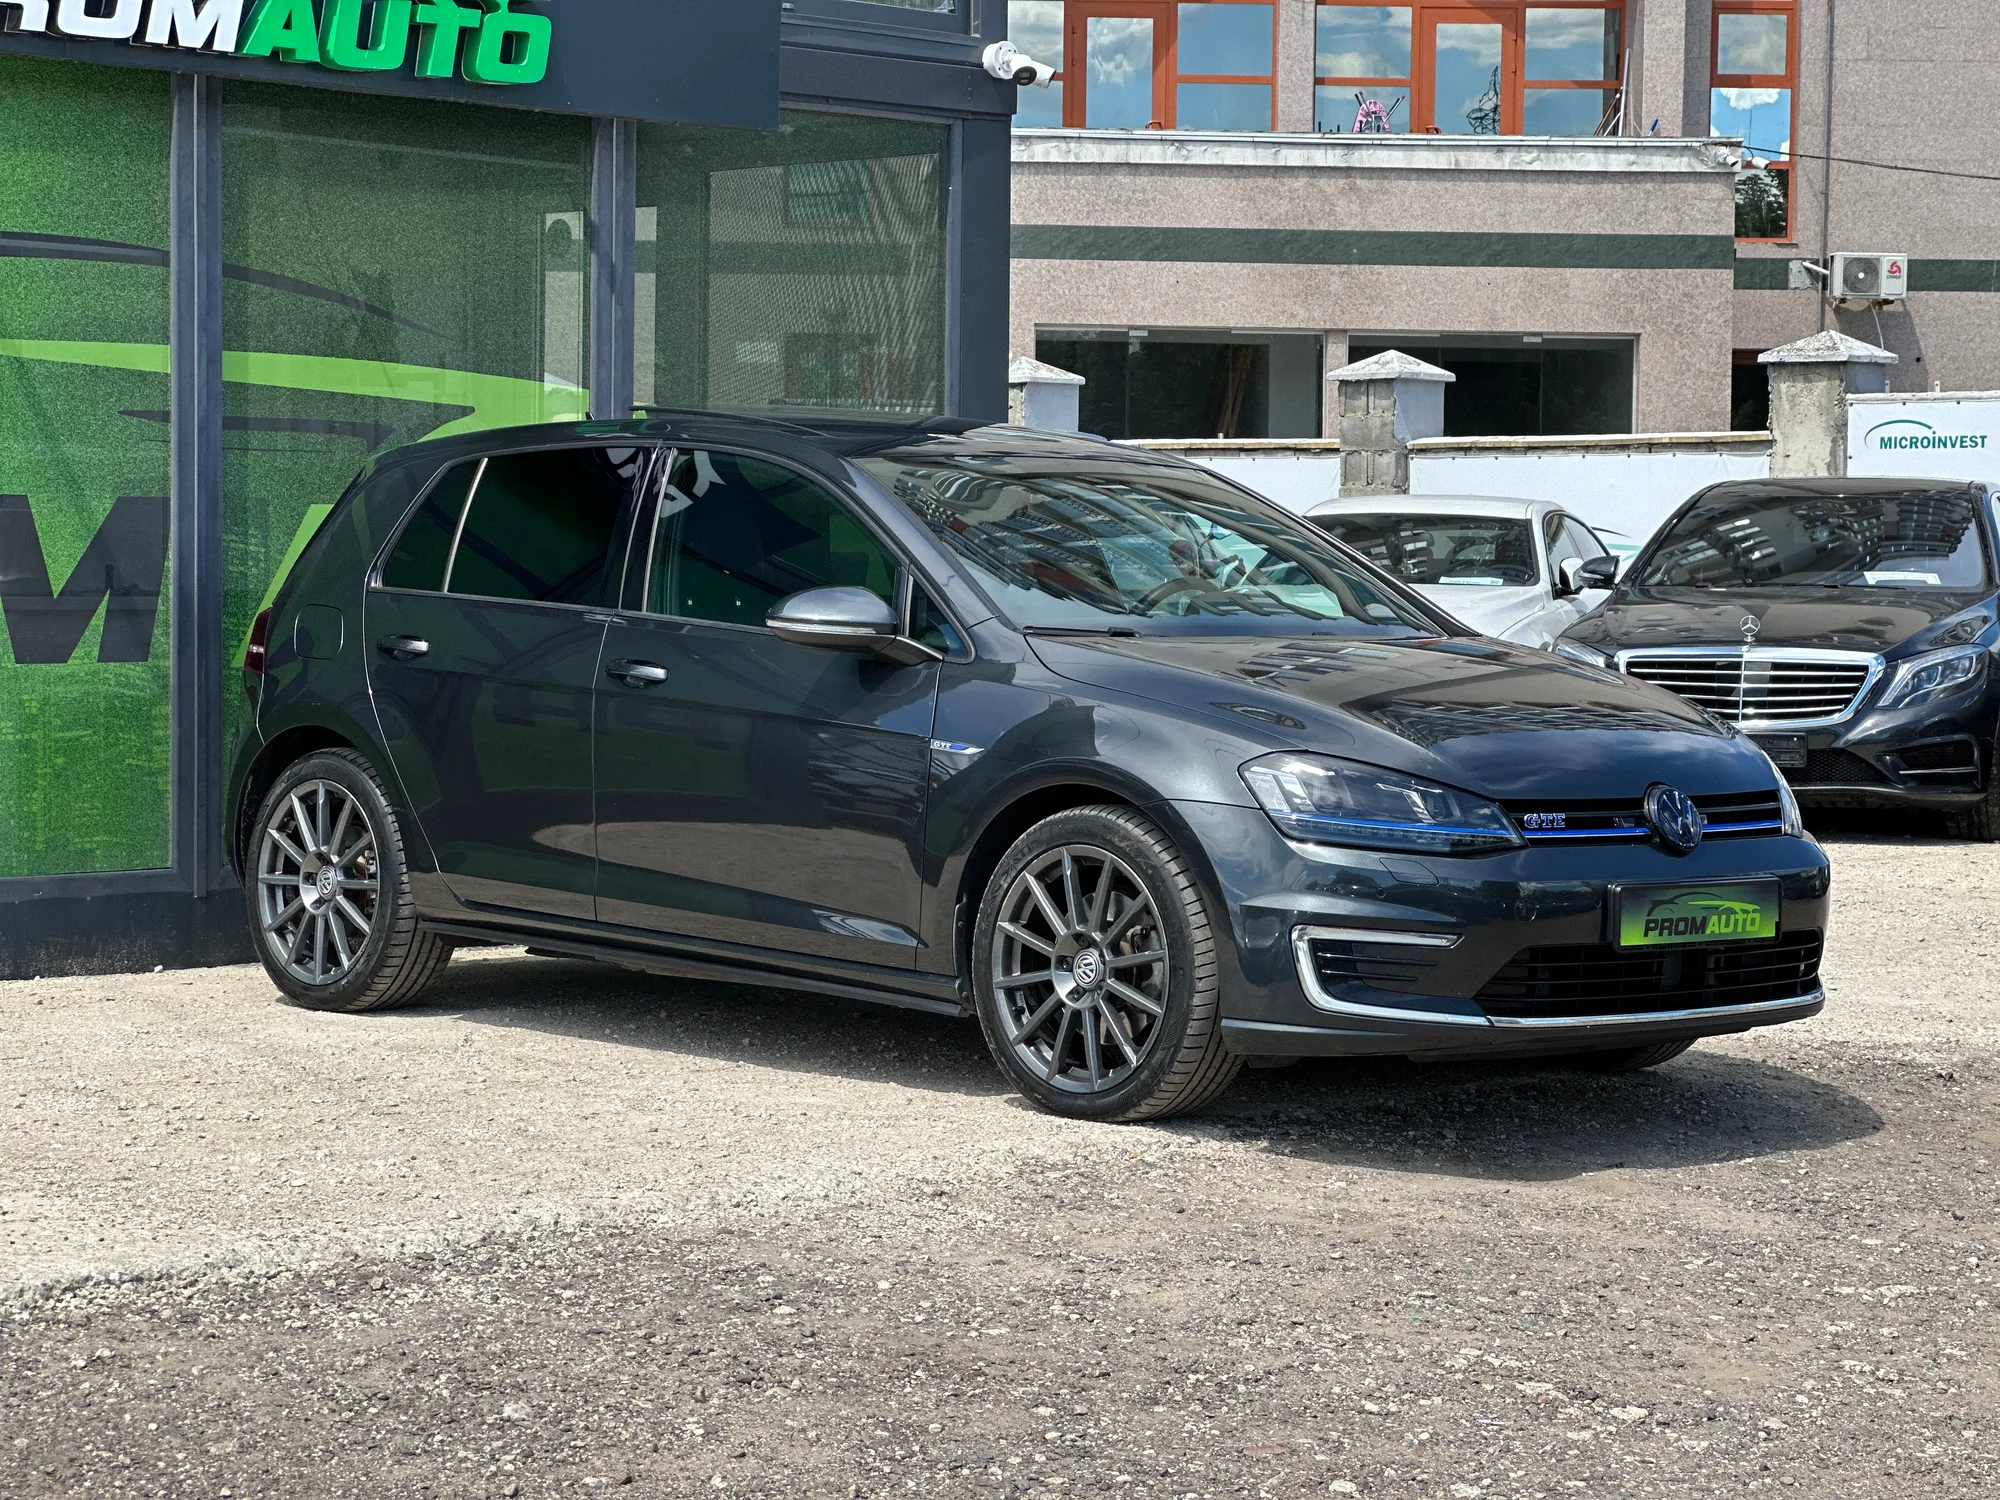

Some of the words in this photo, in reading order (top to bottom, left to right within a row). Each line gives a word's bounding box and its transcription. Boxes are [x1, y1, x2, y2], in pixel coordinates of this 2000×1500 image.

[933, 740, 952, 749] GTE
[1524, 813, 1566, 828] GTE
[1643, 912, 1761, 938] PROMAUTO
